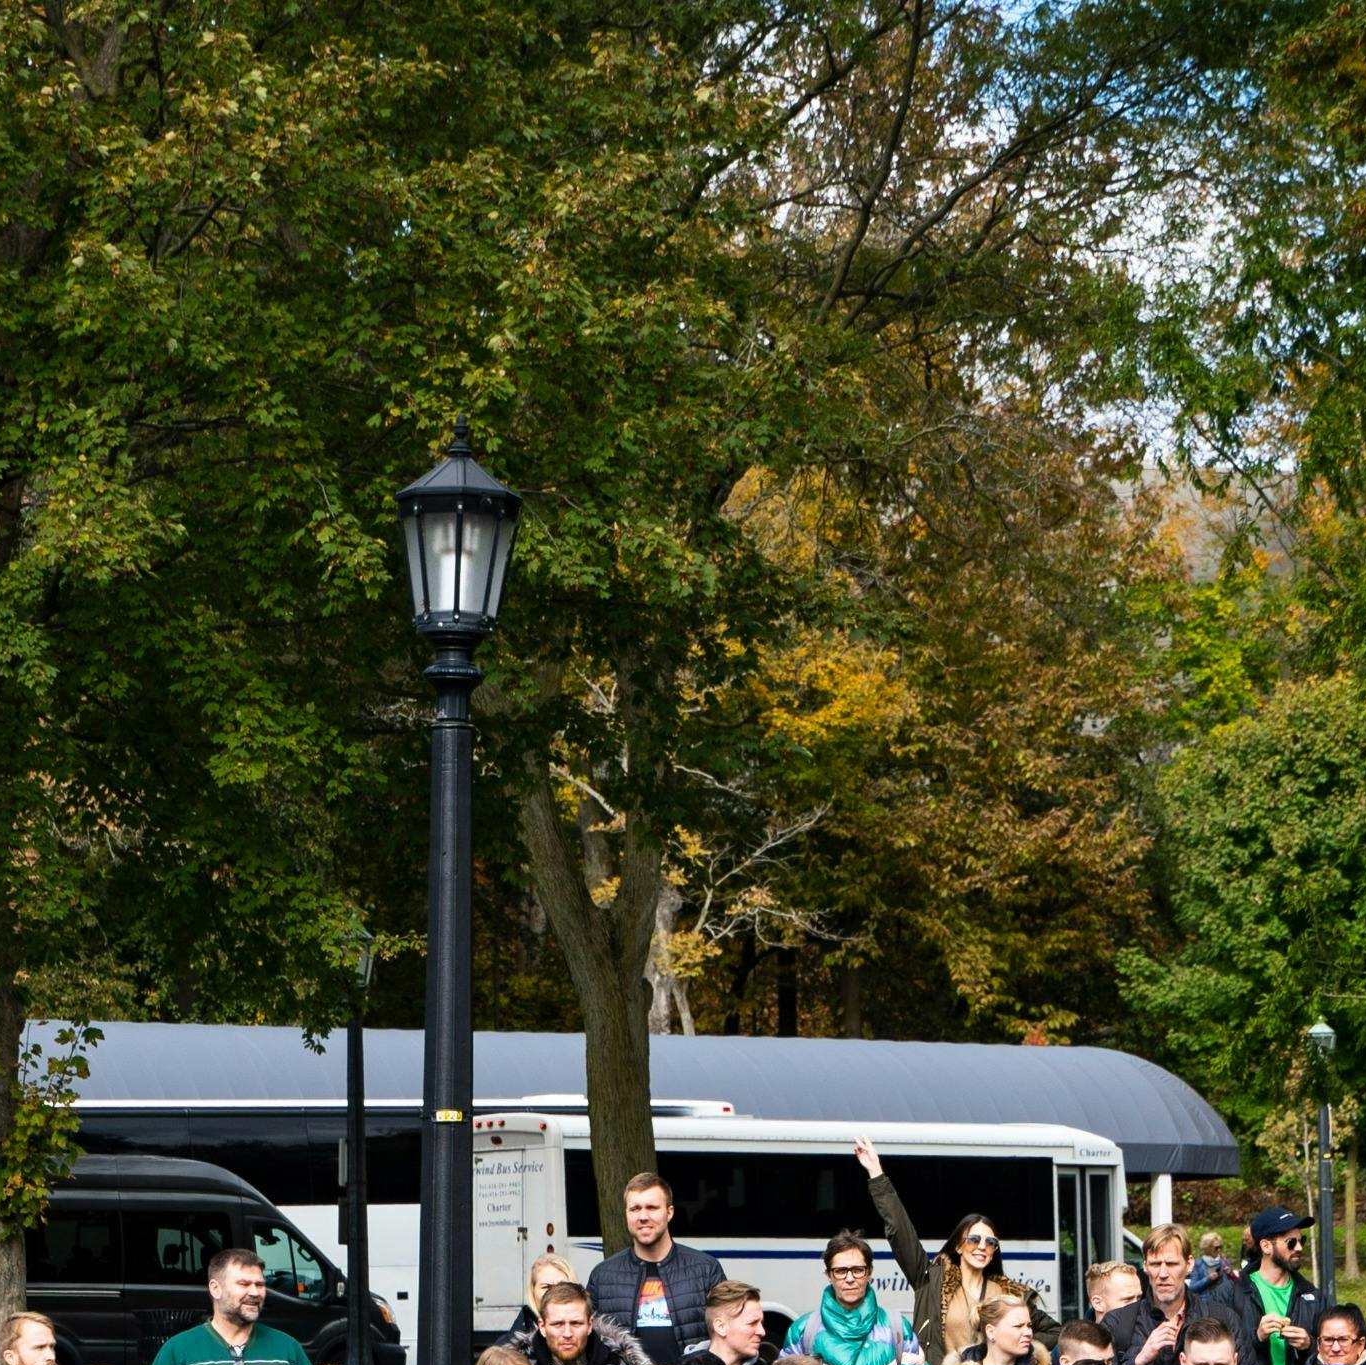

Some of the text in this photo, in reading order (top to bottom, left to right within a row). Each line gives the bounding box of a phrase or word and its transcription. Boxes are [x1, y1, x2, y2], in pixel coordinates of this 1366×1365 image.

[1079, 1149, 1111, 1158] Charter
[497, 1162, 511, 1175] Bus
[513, 1161, 544, 1173] Service
[487, 1202, 512, 1213] Charter
